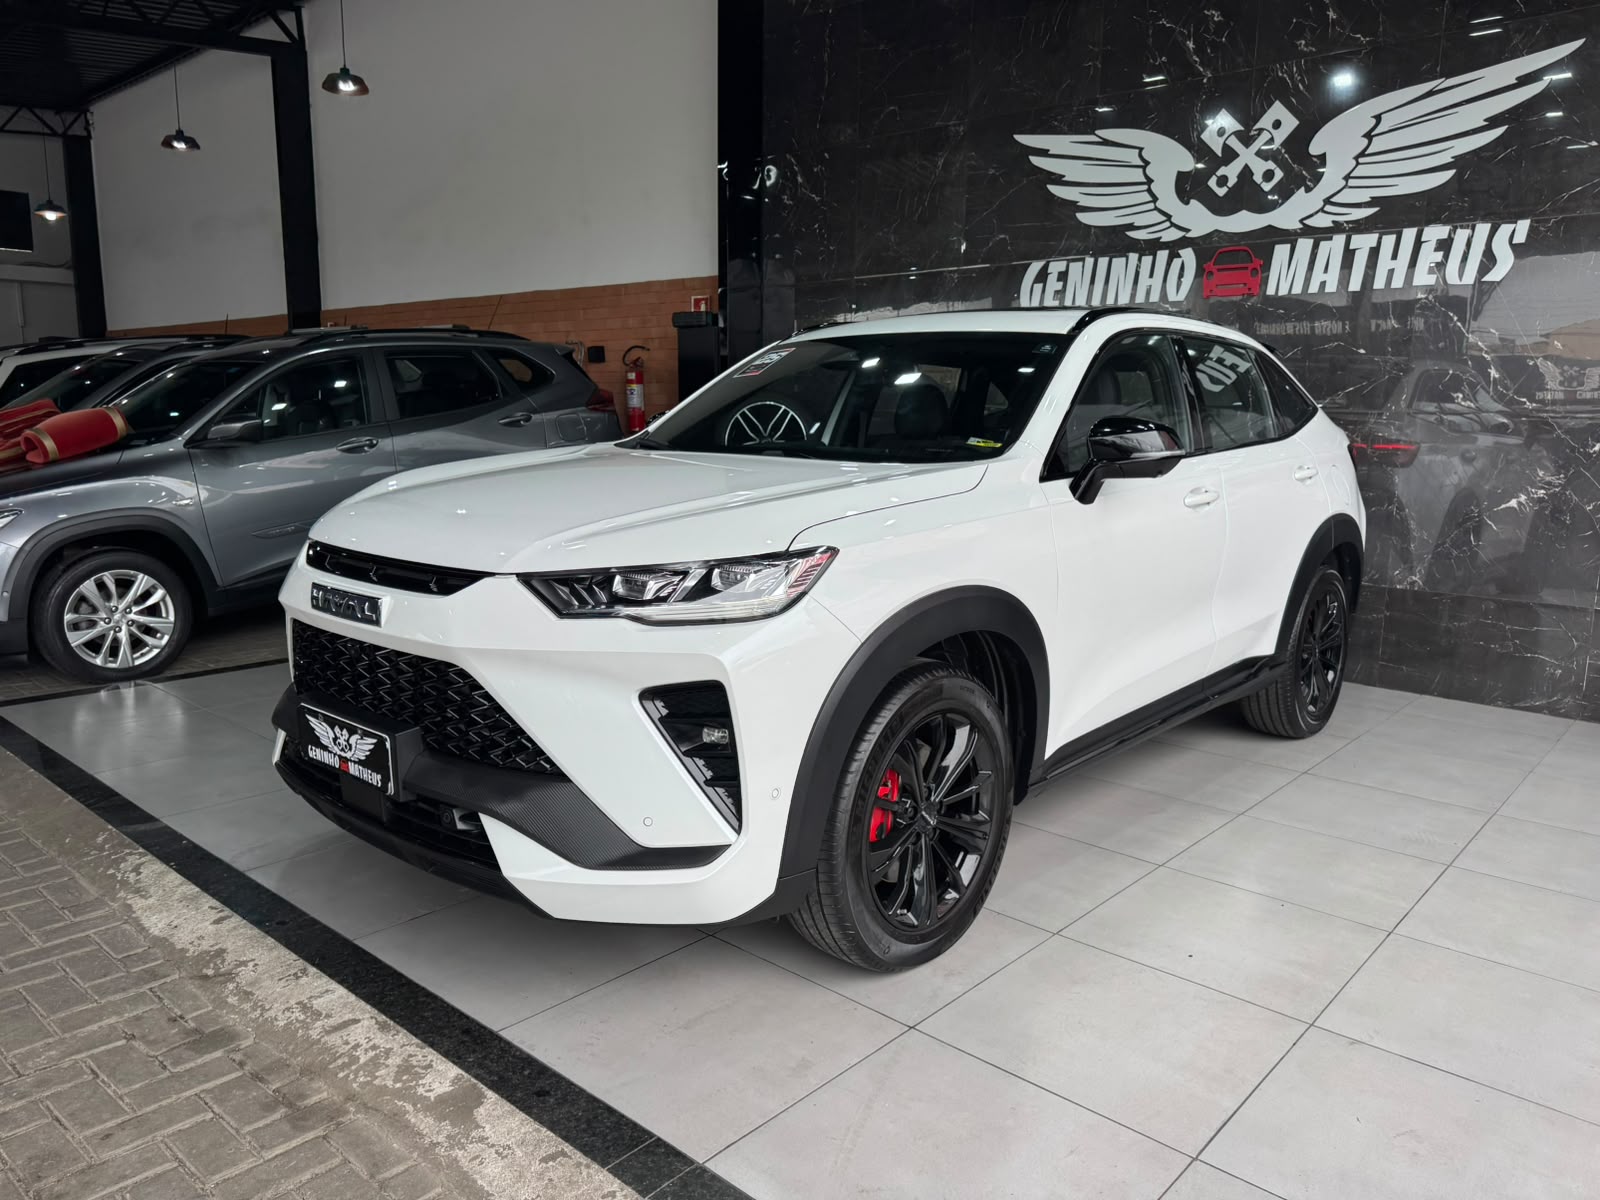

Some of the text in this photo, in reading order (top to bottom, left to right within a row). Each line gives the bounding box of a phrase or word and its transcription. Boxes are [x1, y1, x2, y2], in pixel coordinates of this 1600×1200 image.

[1019, 219, 1530, 308] GENINHO MATHEUS
[308, 744, 382, 787] GENINHO MATHEUS
